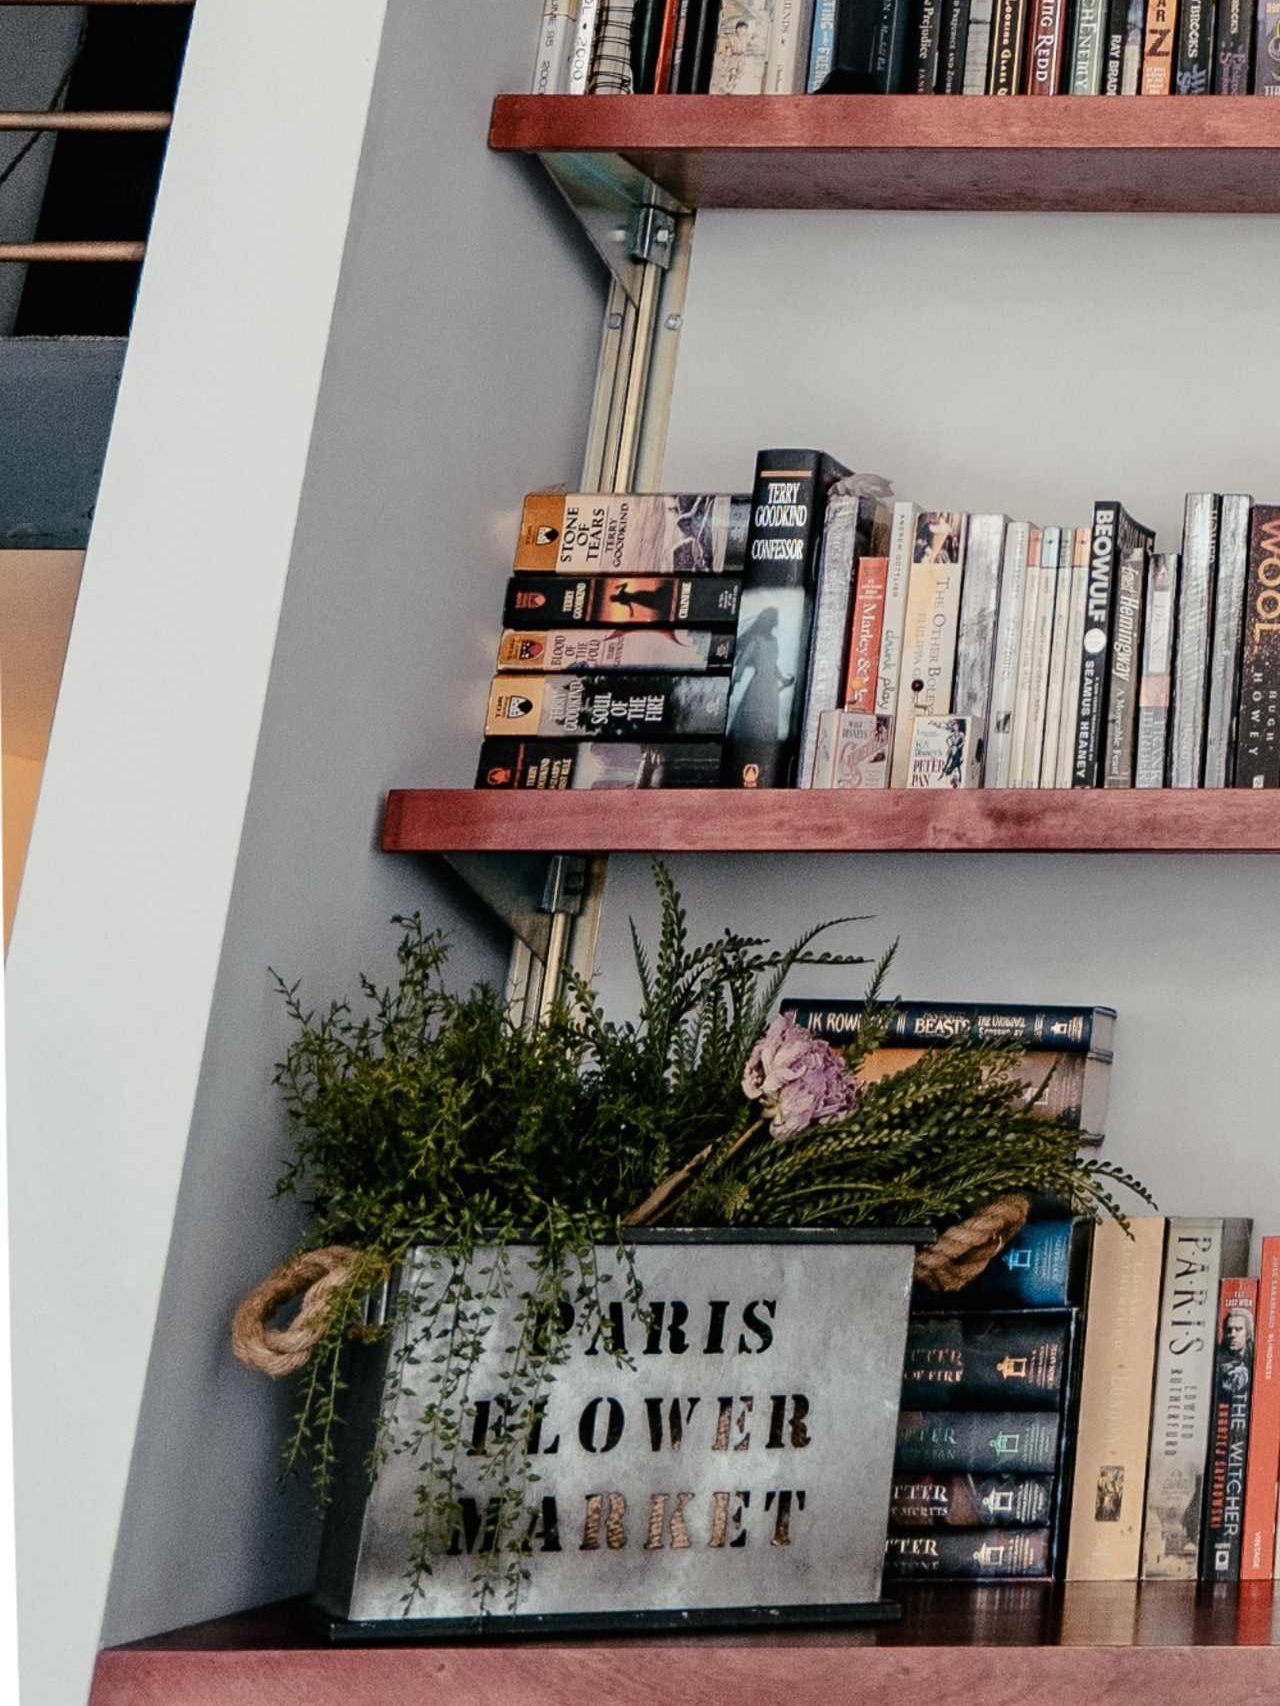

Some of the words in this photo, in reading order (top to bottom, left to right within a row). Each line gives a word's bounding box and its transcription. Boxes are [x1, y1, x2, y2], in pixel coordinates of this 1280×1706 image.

[918, 7, 934, 59] Prejudice
[1109, 34, 1121, 58] RAY
[1145, 28, 1170, 59] Z
[1187, 6, 1202, 59] BROOKS
[572, 36, 588, 81] 2000
[1034, 35, 1057, 82] REDD
[754, 505, 807, 528] GOODKIND
[767, 483, 800, 504] TERRY
[560, 506, 580, 563] STONE
[577, 527, 590, 546] OF
[587, 508, 606, 562] TEARS
[752, 538, 804, 561] CONFESSOR
[1088, 509, 1115, 622] BEOWULF
[1113, 595, 1140, 682] Hemingway
[591, 691, 612, 726] SOUL
[611, 699, 629, 716] OF
[628, 695, 646, 721] THE
[644, 695, 665, 722] FIRE
[1080, 660, 1096, 717] SEAMUS
[1075, 721, 1091, 778] HEANEY
[532, 1298, 778, 1358] PARIS
[1230, 1390, 1248, 1429] THE
[1223, 1441, 1244, 1536] WITCHER
[446, 1488, 806, 1556] MARKET
